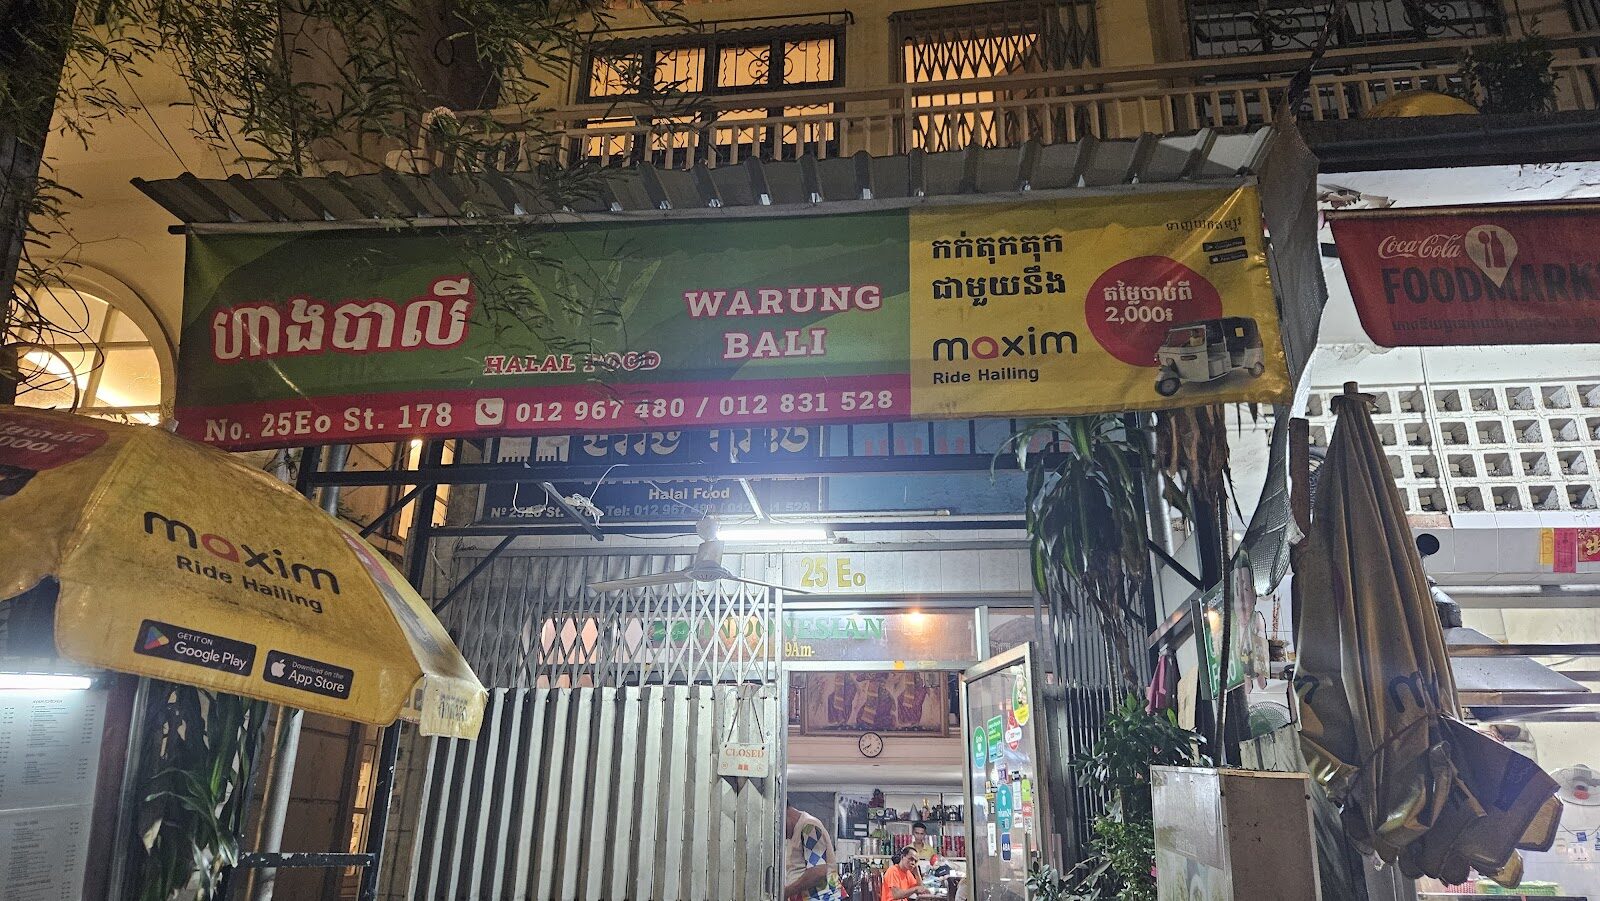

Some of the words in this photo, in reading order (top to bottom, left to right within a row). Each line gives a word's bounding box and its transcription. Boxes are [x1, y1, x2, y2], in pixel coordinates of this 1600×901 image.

[1378, 234, 1463, 259] Coca-Cola
[932, 265, 1066, 306] ជាមួយនឹង
[685, 286, 881, 317] WARUNG
[212, 278, 471, 360] ហាងបាលី
[723, 328, 826, 359] BALI
[933, 326, 1078, 361] maxim
[483, 354, 577, 376] HALAL
[933, 371, 971, 384] Ride
[978, 367, 1039, 382] Hailing
[516, 402, 562, 422] 012
[574, 400, 624, 420] 967
[635, 398, 685, 418] 480
[719, 395, 768, 416] 012
[780, 393, 828, 413] 831
[841, 391, 893, 409] 528
[204, 419, 251, 442] No.
[261, 411, 332, 437] 25Eo
[343, 408, 384, 430] St.
[398, 403, 453, 428] 178
[649, 488, 687, 500] Halal
[693, 487, 730, 499] Food
[546, 506, 564, 518] St.
[634, 504, 659, 516] 012
[144, 511, 340, 594] maxim
[177, 554, 232, 584] Ride
[242, 574, 323, 614] Hailing
[801, 558, 828, 588] 25
[837, 558, 866, 588] Eo
[177, 632, 193, 641] GET
[194, 635, 201, 644] IT
[201, 637, 213, 646] ON
[174, 641, 220, 663] Google
[222, 652, 248, 671] Play
[292, 661, 323, 676] Download
[288, 669, 313, 687] App
[314, 675, 345, 693] Store
[725, 748, 765, 759] CLOSED
